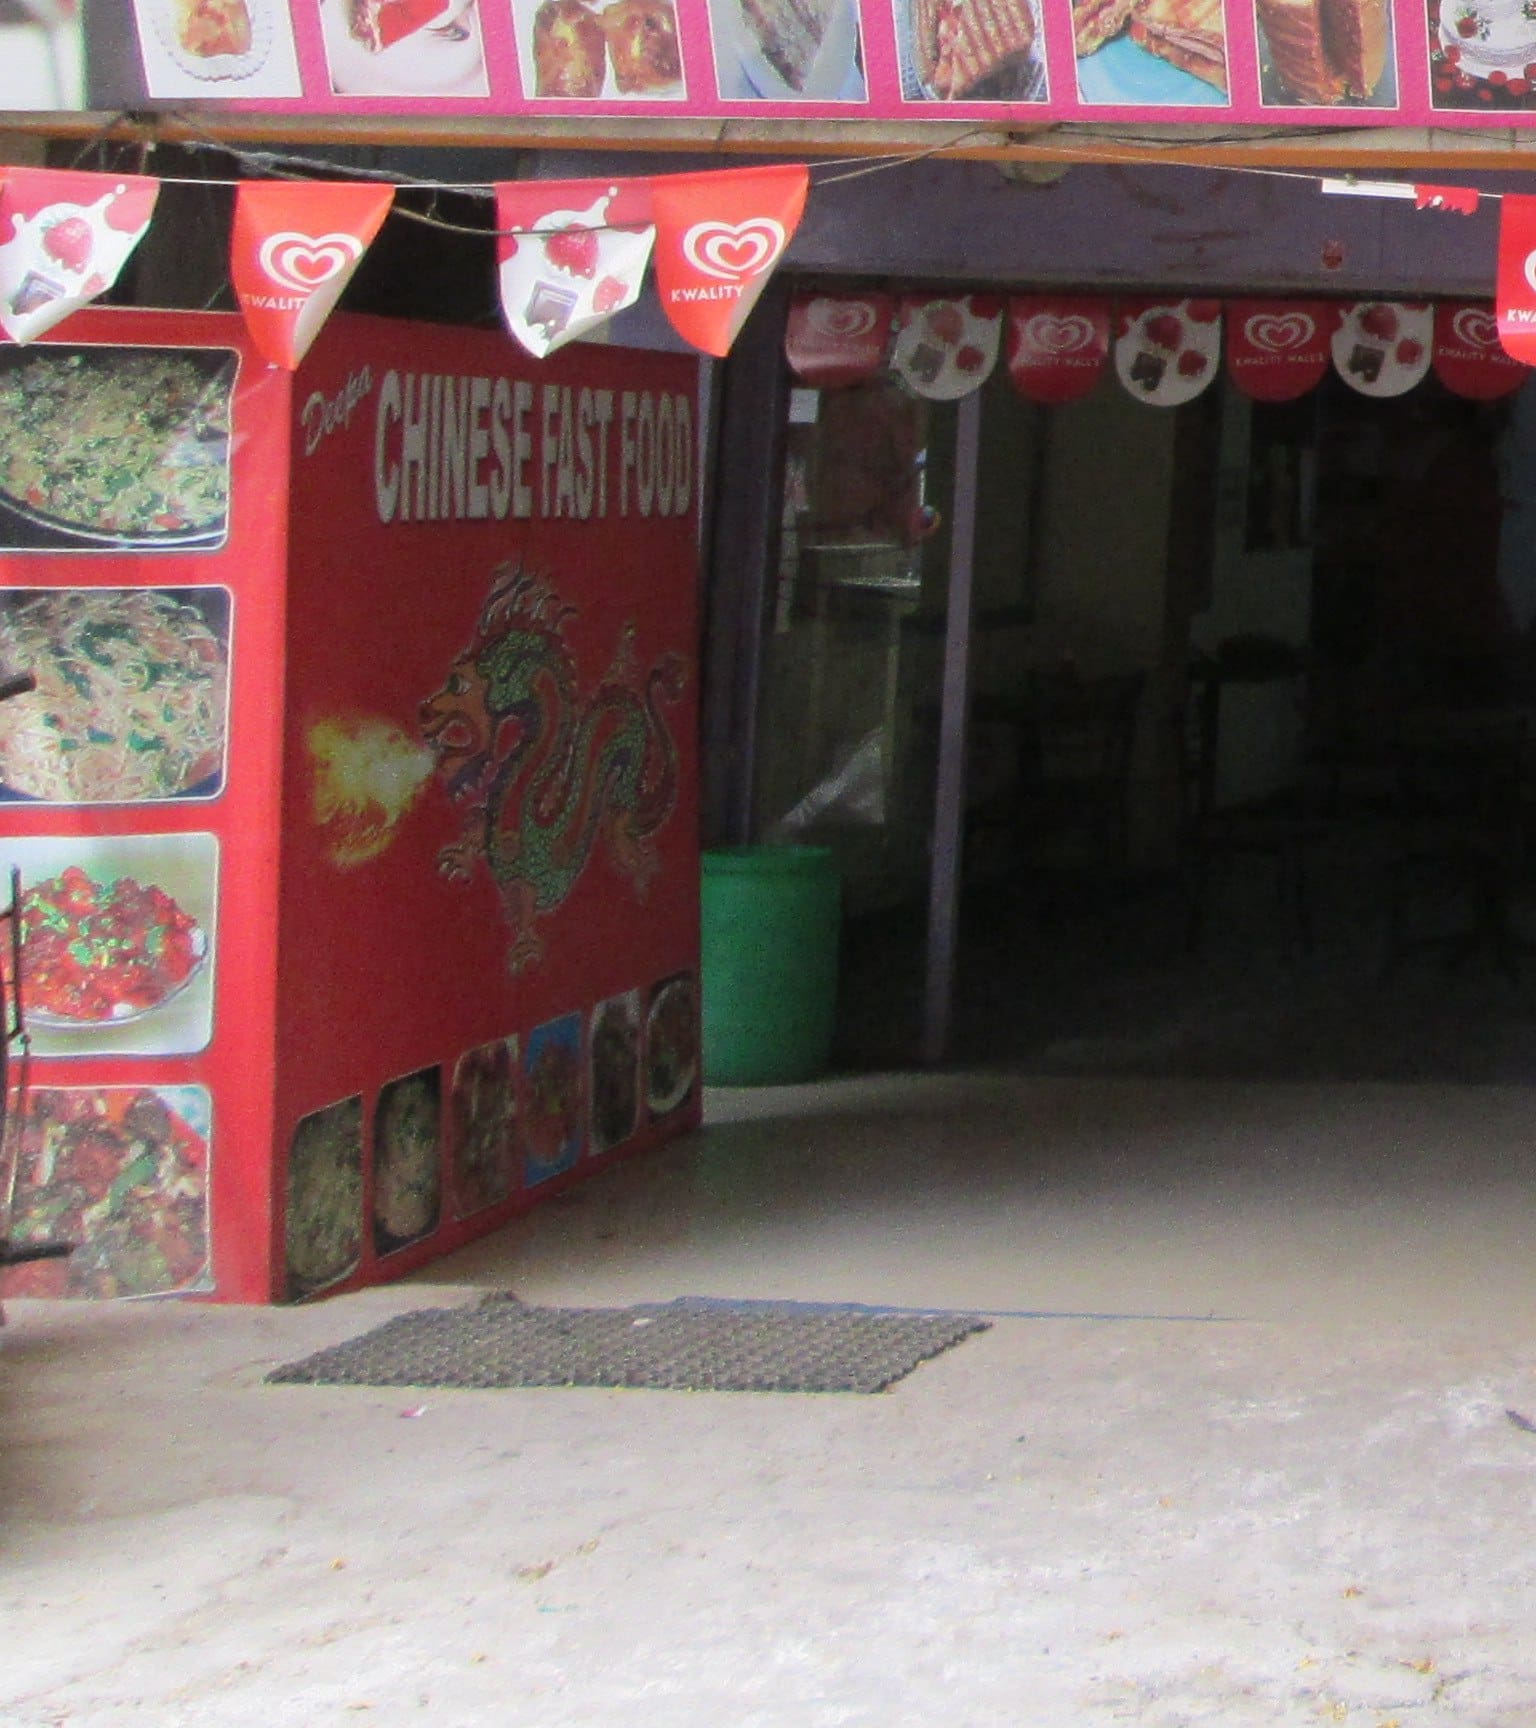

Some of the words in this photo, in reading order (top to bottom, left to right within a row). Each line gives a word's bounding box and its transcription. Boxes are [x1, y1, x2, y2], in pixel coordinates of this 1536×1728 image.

[241, 293, 306, 311] KWALIT
[671, 285, 744, 302] KWALITY
[302, 364, 373, 456] Deepa
[375, 369, 531, 524] CHINESE
[541, 382, 614, 522] FAST
[620, 389, 693, 518] FOOD
